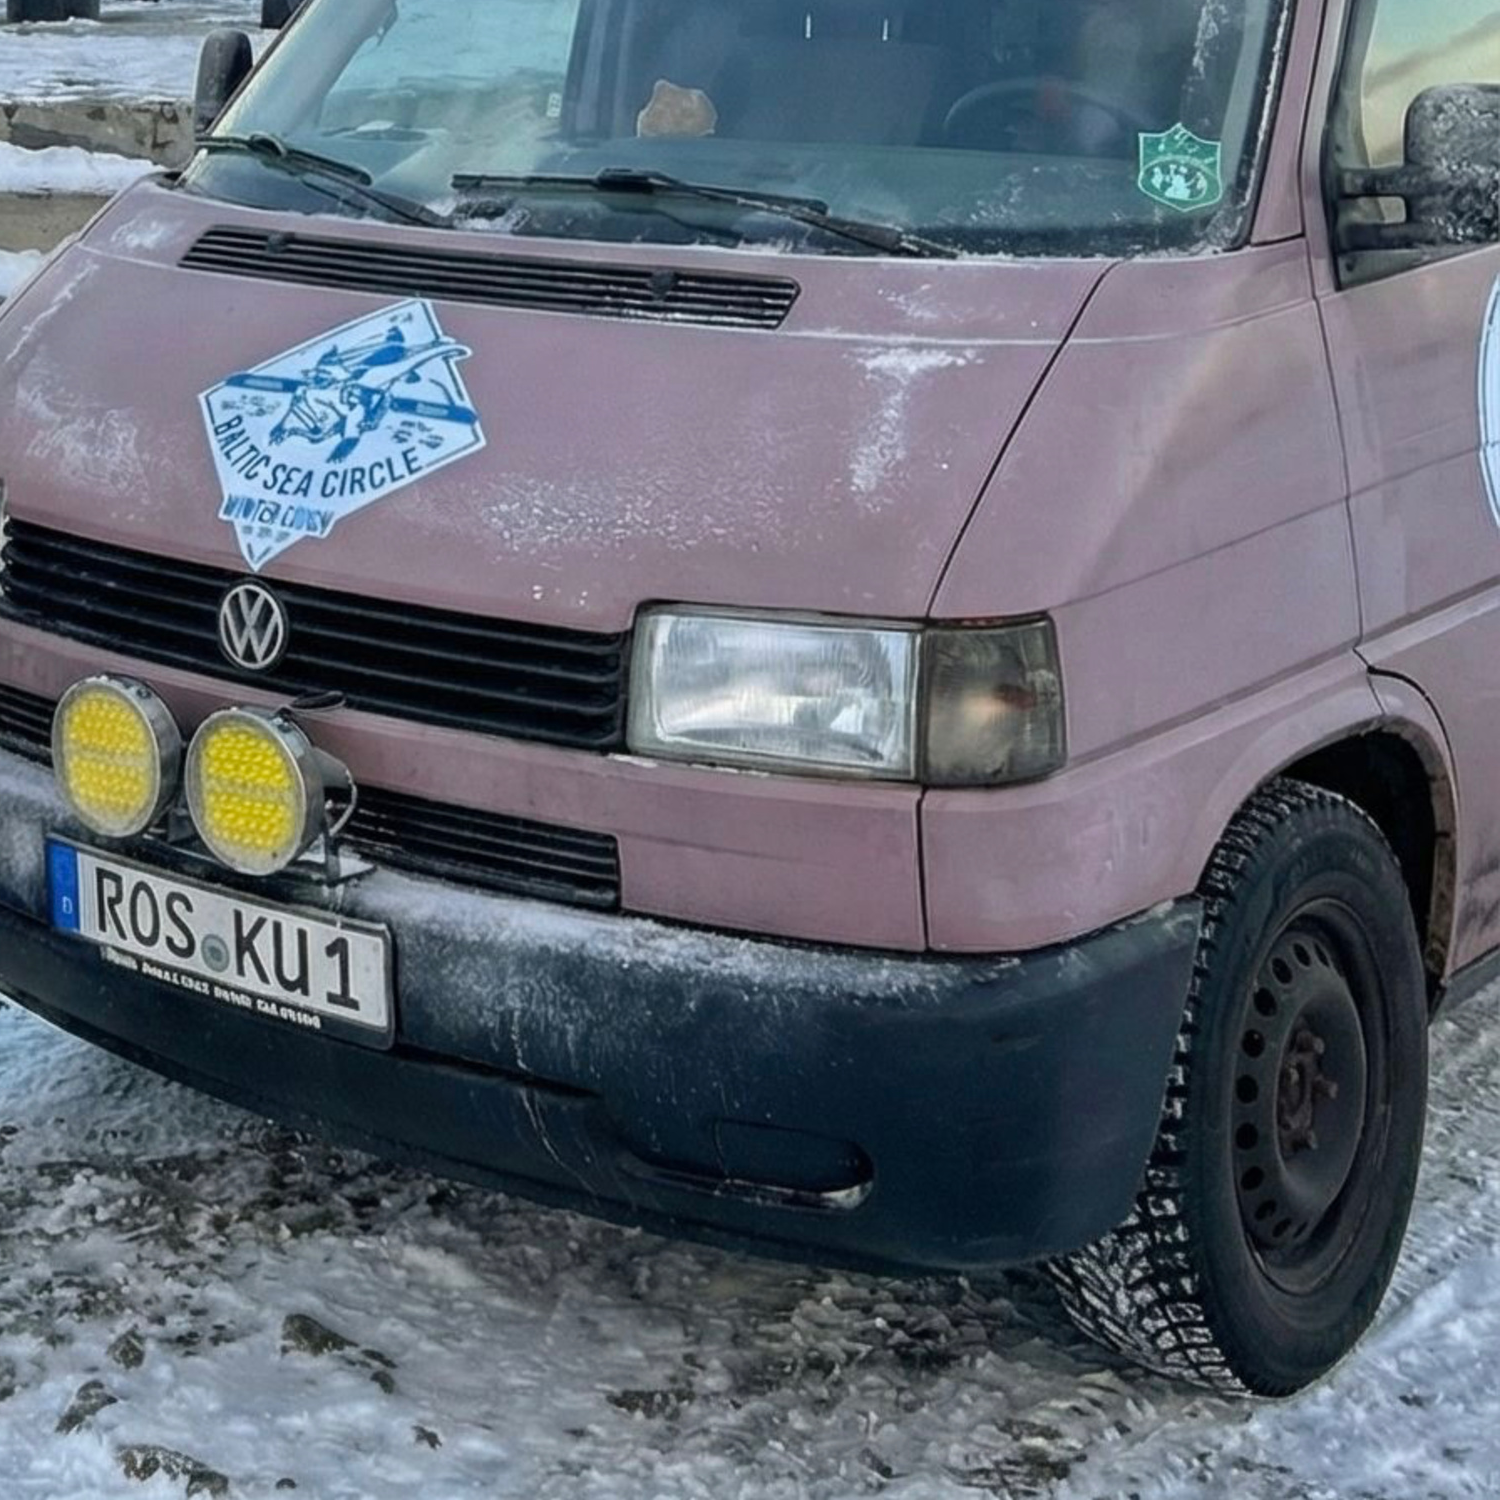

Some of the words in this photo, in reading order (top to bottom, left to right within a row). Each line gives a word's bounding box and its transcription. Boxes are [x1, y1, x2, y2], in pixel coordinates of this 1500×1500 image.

[213, 414, 272, 480] BALTIC
[262, 463, 314, 499] SEA
[319, 447, 423, 499] CIRCLE
[95, 866, 197, 960] ROS
